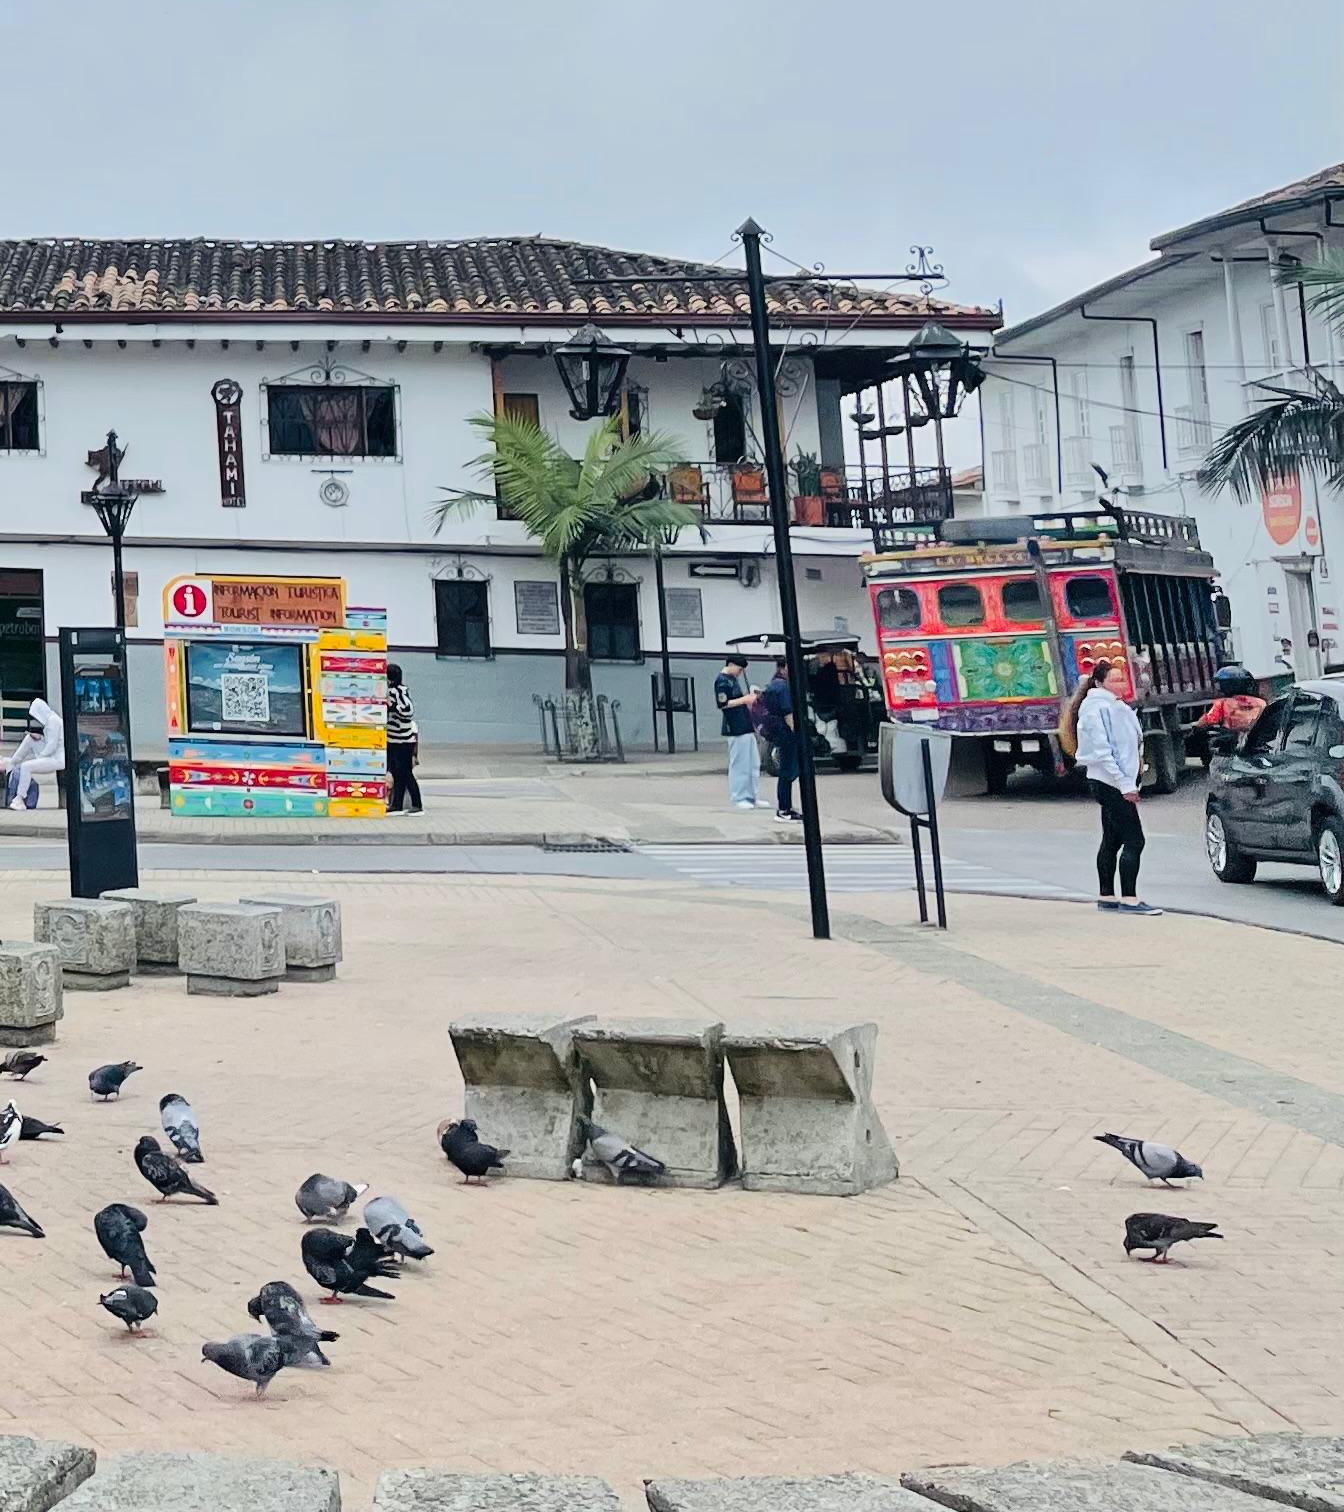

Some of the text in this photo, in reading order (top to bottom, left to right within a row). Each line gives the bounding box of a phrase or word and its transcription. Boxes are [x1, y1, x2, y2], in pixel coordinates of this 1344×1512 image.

[223, 410, 239, 495] TAHAMI
[218, 606, 336, 623] TOURIST INFORMATION
